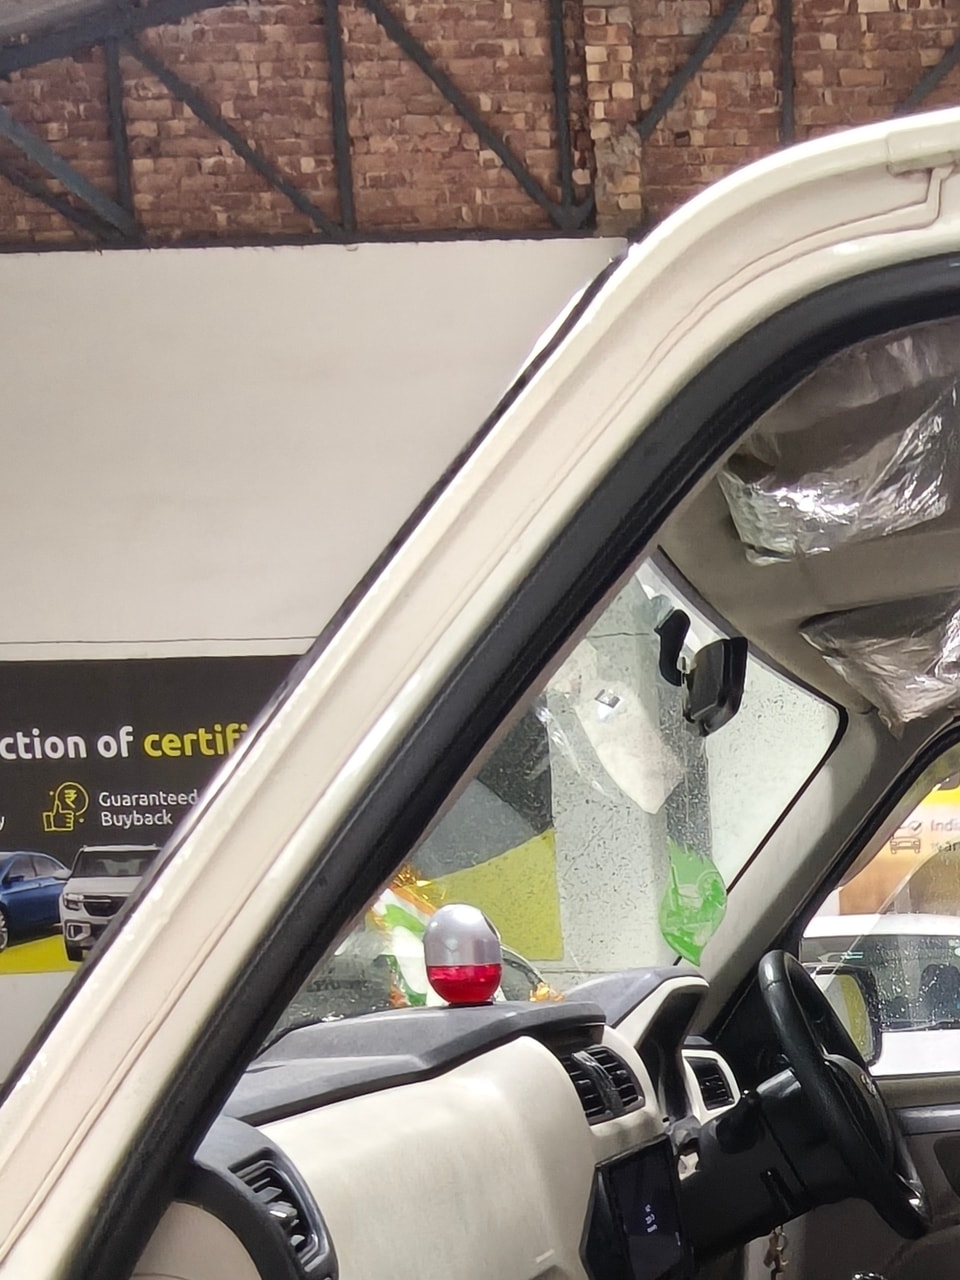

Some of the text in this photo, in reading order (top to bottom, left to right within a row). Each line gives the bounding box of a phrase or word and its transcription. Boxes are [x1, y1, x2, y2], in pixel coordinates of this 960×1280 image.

[0, 723, 248, 760] ction of certif
[98, 789, 198, 808] Guaranteed
[100, 809, 174, 829] Buyback
